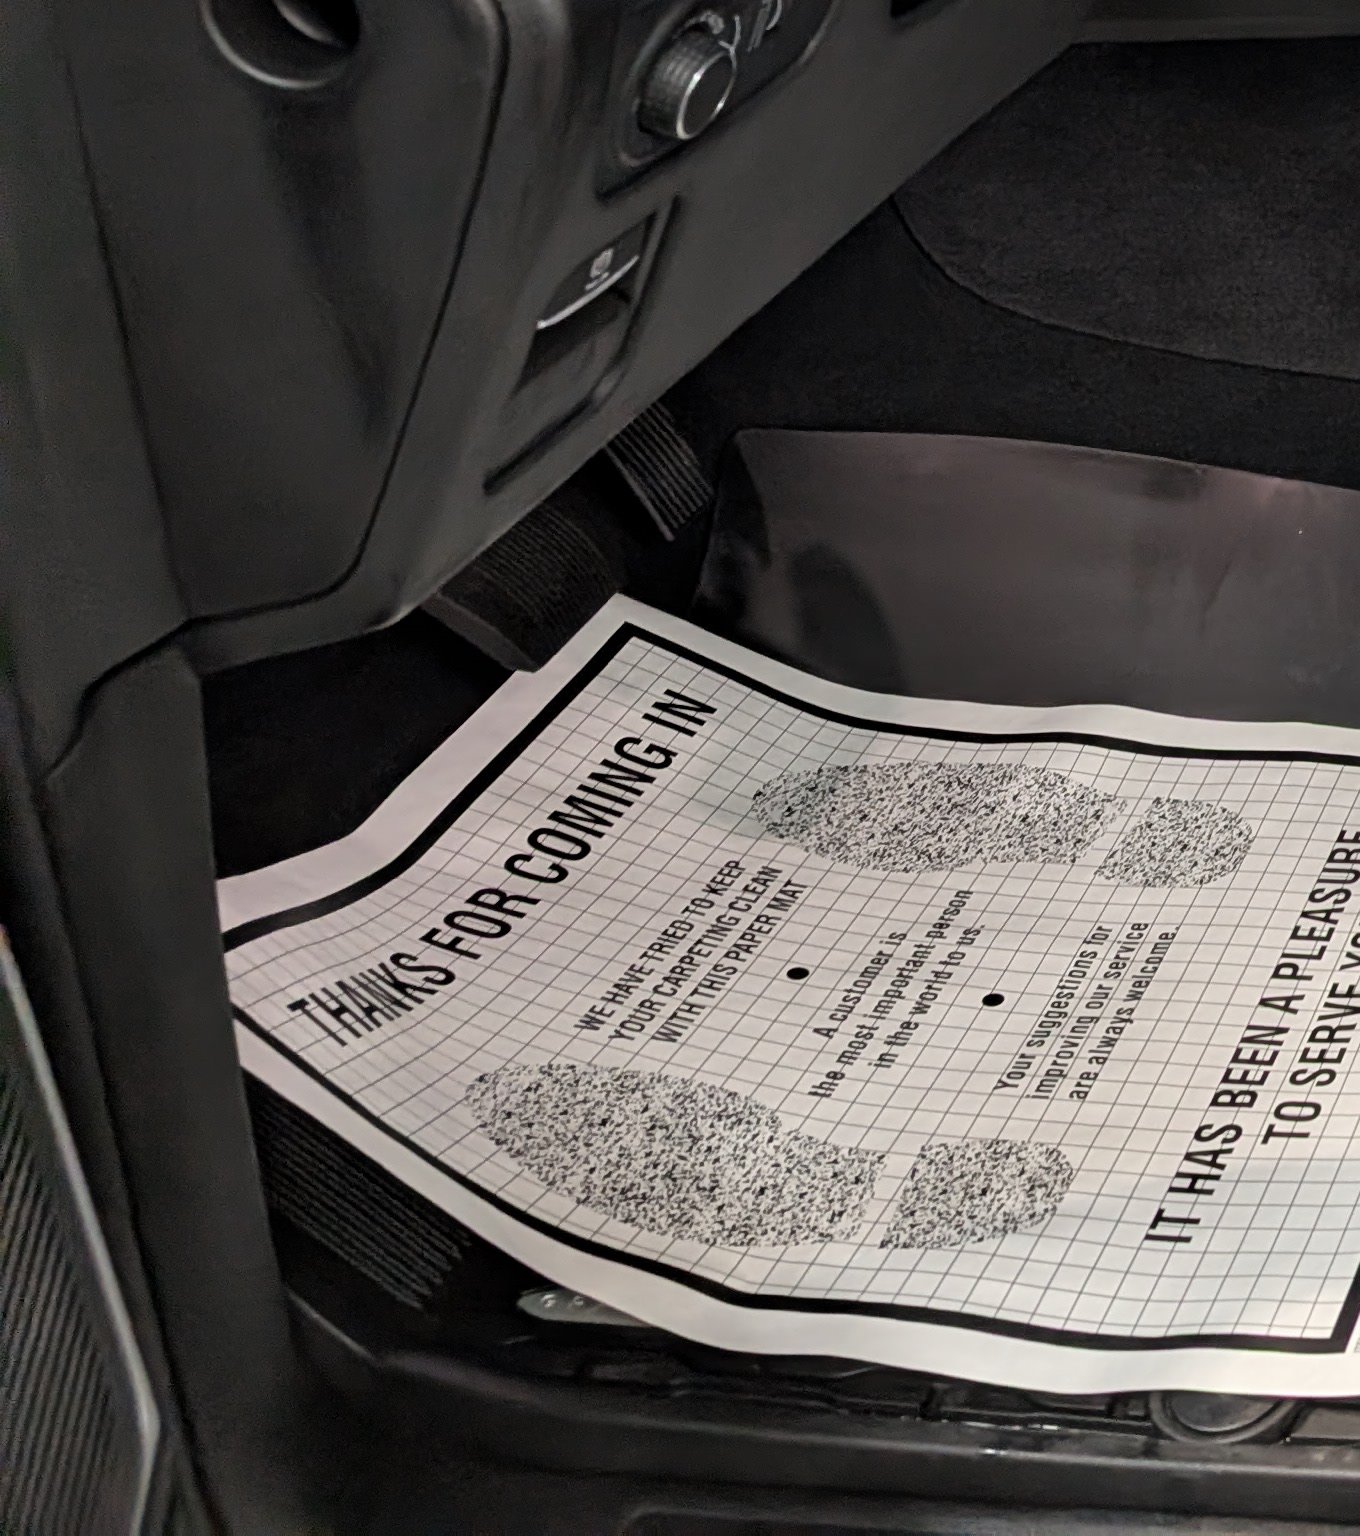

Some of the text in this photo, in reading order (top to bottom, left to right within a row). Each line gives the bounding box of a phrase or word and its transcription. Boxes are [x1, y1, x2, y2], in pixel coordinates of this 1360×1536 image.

[287, 689, 718, 1046] THANKS FOR COMING IN
[573, 860, 746, 1031] WE HAVE TRIED TO KEEP
[608, 866, 783, 1041] YOUR CARPETING CLEAN
[650, 880, 809, 1043] WITH THIS PAPER MAT
[808, 889, 974, 1098] the most important person
[812, 931, 907, 1040] A customer is
[867, 925, 986, 1069] in the world to us.
[993, 925, 1113, 1091] Your suggestions for
[1024, 922, 1149, 1100] improving our service
[1069, 927, 1180, 1100] are always welcome.
[1259, 994, 1305, 1015] A
[1209, 1025, 1290, 1108] BEEN
[1261, 1099, 1323, 1145] TO
[1144, 1208, 1202, 1243] IT
[1167, 1123, 1243, 1196] HAS
